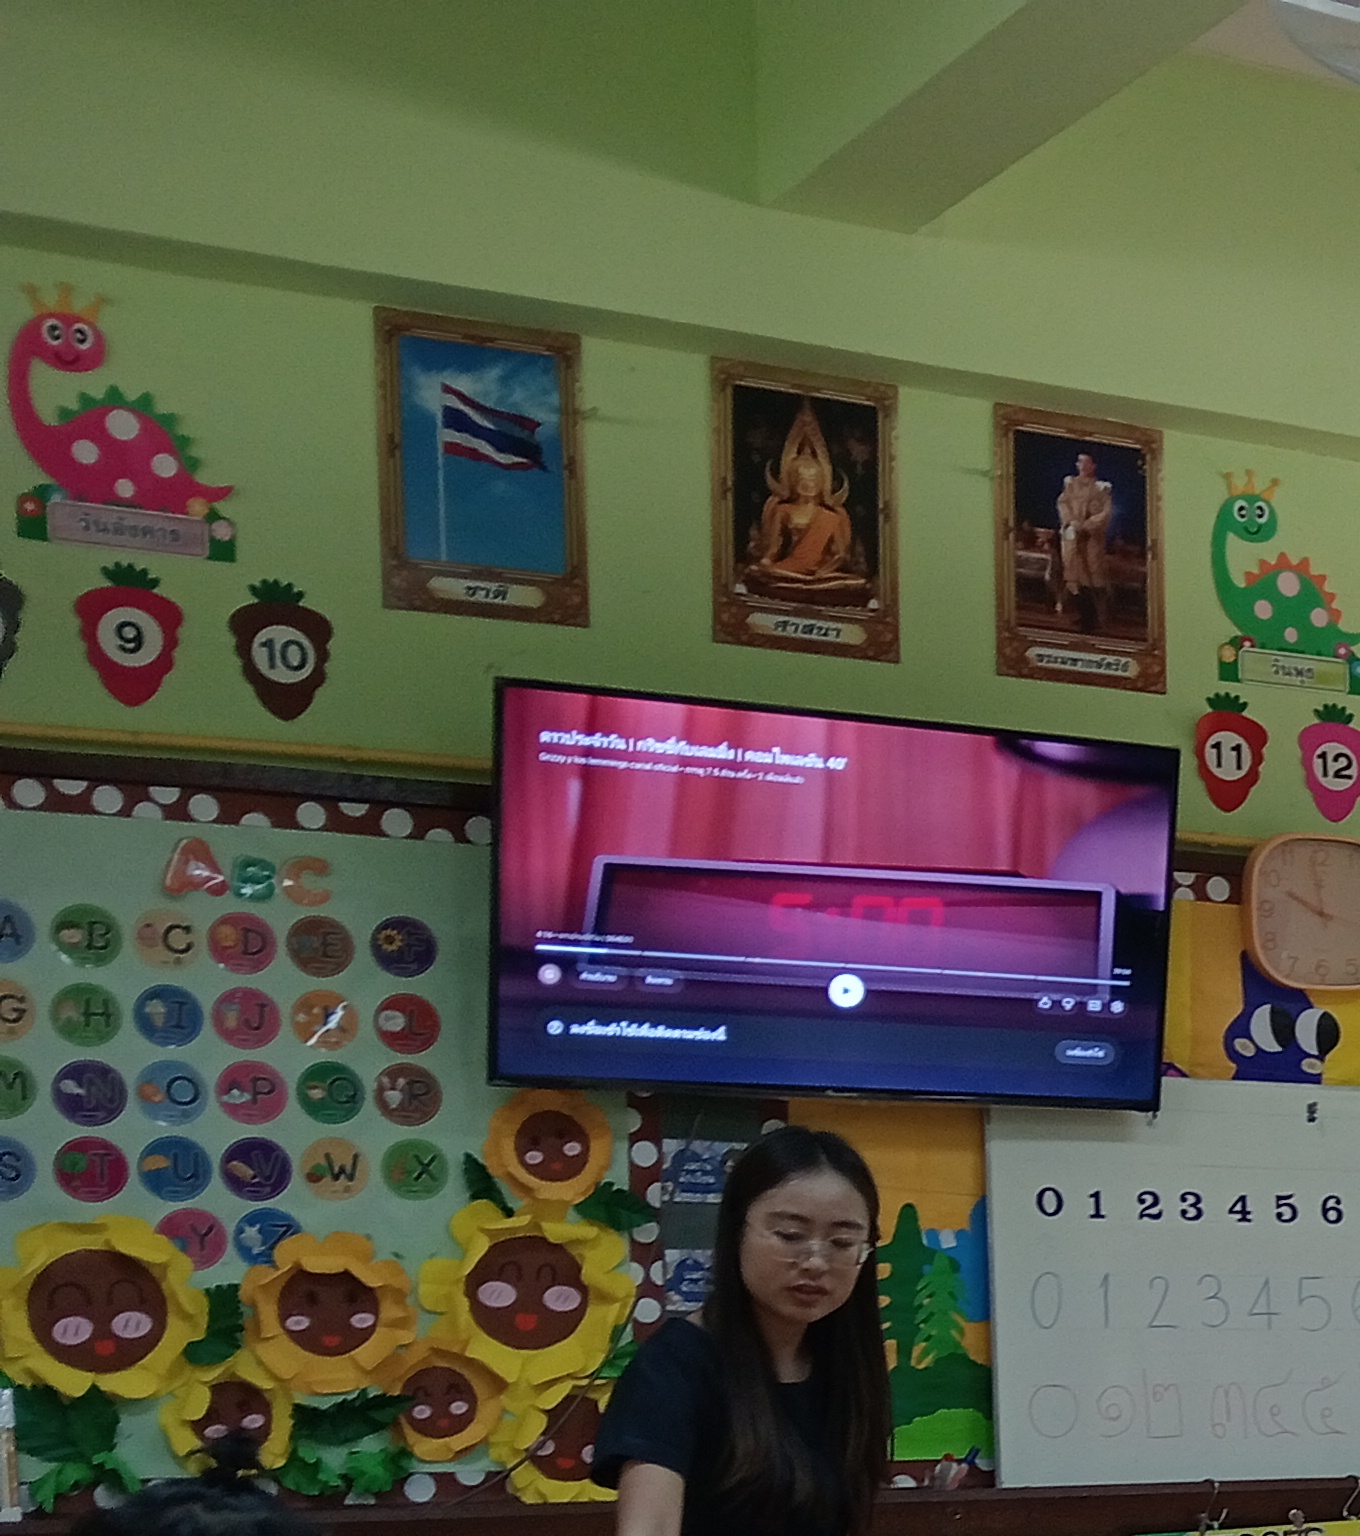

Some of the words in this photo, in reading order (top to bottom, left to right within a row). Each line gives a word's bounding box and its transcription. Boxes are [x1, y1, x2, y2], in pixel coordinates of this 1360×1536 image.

[465, 585, 508, 601] ชาติ
[116, 619, 143, 654] 9
[259, 636, 308, 673] 10
[774, 620, 841, 639] ศาสนา
[1272, 658, 1315, 685] วันพุธ
[1210, 741, 1243, 771] 11
[1316, 751, 1354, 780] 12
[87, 920, 111, 951] B
[162, 923, 195, 956] C
[242, 931, 267, 956] D
[322, 933, 342, 958] E
[1314, 958, 1331, 976] 6
[0, 994, 27, 1025] G
[83, 997, 112, 1029] H
[175, 1001, 197, 1030] I
[244, 1003, 269, 1032] J
[84, 1074, 118, 1109] N
[165, 1075, 200, 1107] O
[251, 1076, 276, 1106] P
[409, 1080, 430, 1108] R
[0, 1151, 22, 1182] S
[88, 1152, 113, 1183] T
[172, 1152, 199, 1182] U
[250, 1152, 283, 1182] V
[324, 1152, 360, 1183] W
[412, 1153, 440, 1183] X
[1036, 1186, 1064, 1217] 0
[1087, 1190, 1107, 1220] 1
[1137, 1191, 1163, 1221] 2
[1179, 1191, 1204, 1222] 3
[1228, 1194, 1254, 1223] 4
[1274, 1194, 1299, 1224] 5
[1320, 1196, 1345, 1225] 6
[190, 1223, 215, 1251] Y
[1029, 1272, 1063, 1329] 0
[1099, 1272, 1113, 1328] 1
[1147, 1275, 1179, 1328] 2
[1198, 1274, 1230, 1329] 3
[1247, 1276, 1282, 1330] 4
[1298, 1276, 1333, 1332] 5
[1096, 1385, 1136, 1438] ๑
[1143, 1368, 1184, 1439] ๒
